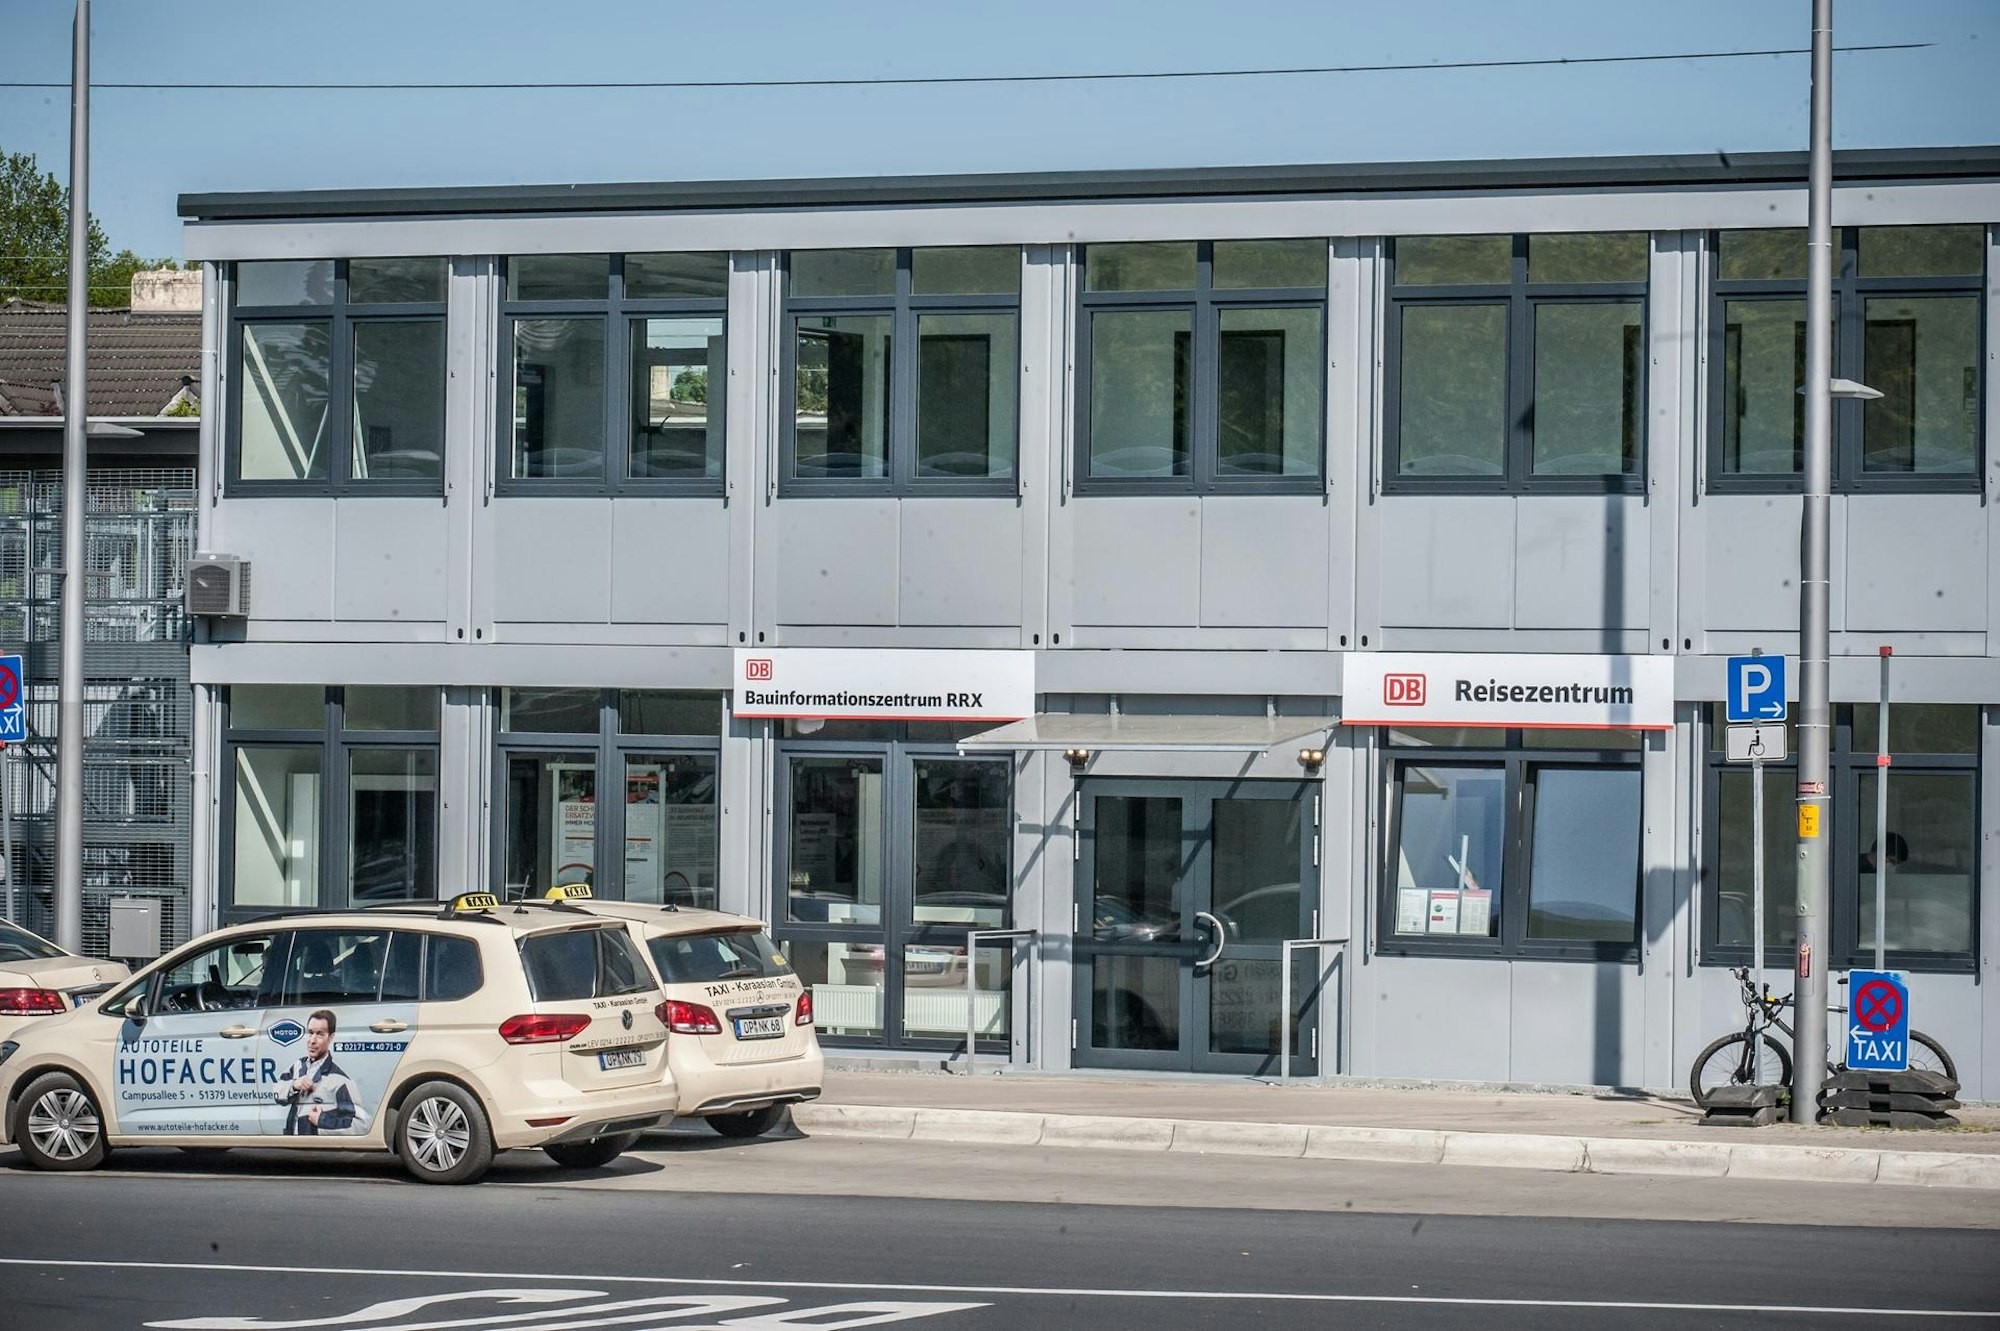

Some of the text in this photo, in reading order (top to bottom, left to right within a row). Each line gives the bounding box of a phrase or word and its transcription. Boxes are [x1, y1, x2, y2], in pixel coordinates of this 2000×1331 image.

[749, 662, 770, 677] DB
[1388, 677, 1422, 702] DB
[1455, 679, 1633, 704] Reisezentrum
[1741, 664, 1772, 712] P
[745, 690, 983, 708] Bauinformationszentrum RRX
[565, 887, 588, 897] TAXI
[470, 896, 492, 907] TAXI
[705, 983, 730, 997] TAXI
[735, 980, 777, 992] Karaaslan
[593, 1001, 607, 1010] TAXI
[759, 1021, 769, 1033] NK
[771, 1019, 781, 1031] 68
[120, 1040, 203, 1053] AUTOTEILE
[1854, 1040, 1902, 1062] TAXI
[120, 1058, 278, 1084] HOFACKER
[122, 1090, 279, 1102] Campusallee 5 51379 Leverkusen
[138, 1122, 240, 1131] www.autoteile-hofacker.de
